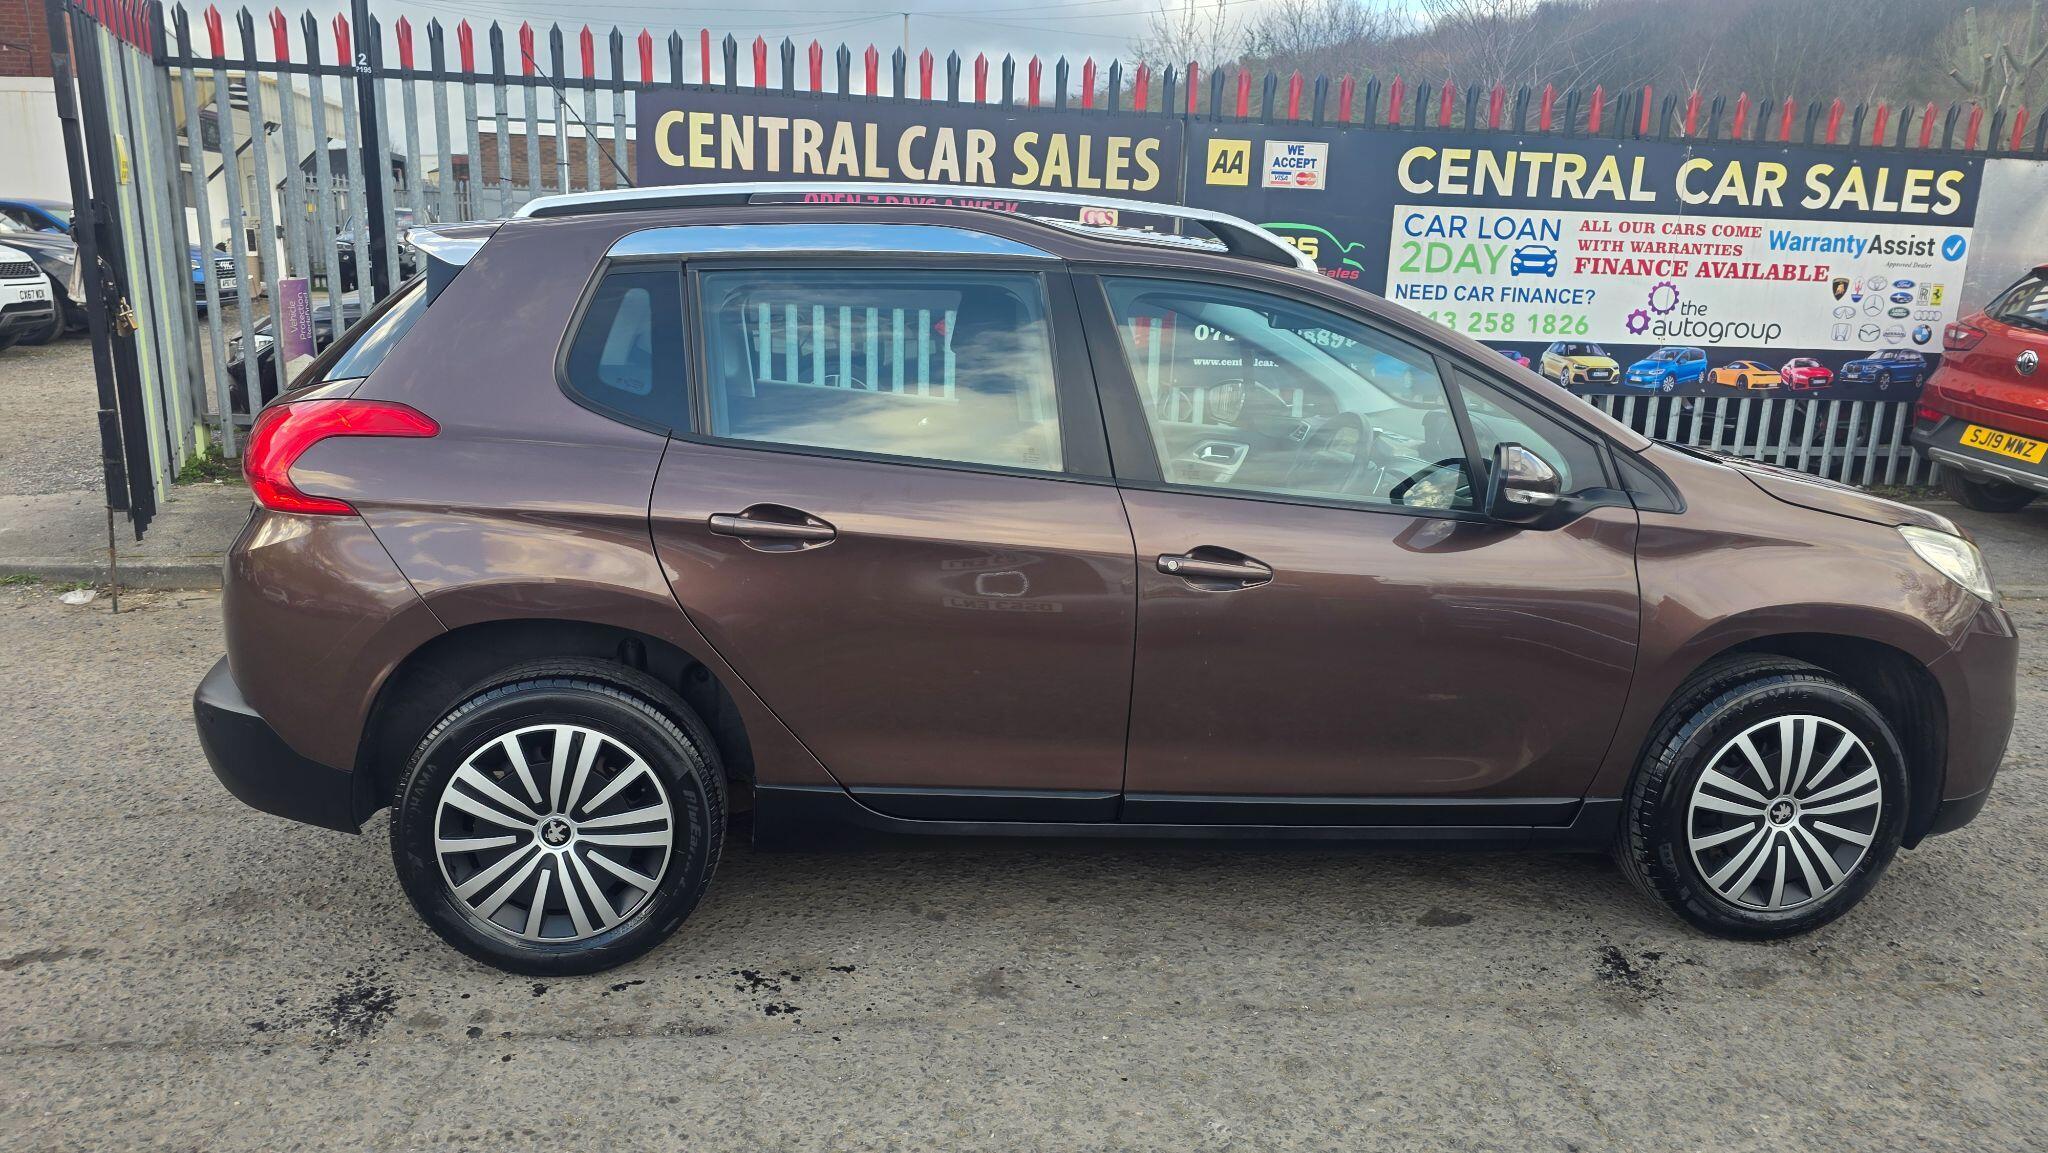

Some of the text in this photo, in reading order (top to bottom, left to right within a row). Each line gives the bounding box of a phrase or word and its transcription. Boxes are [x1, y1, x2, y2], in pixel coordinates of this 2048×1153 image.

[358, 53, 367, 65] 2
[655, 111, 1160, 192] CENTRAL CAR SALES
[1211, 149, 1244, 174] AA
[1287, 144, 1305, 156] WE
[1272, 157, 1318, 169] ACCEPT
[1398, 146, 1965, 215] CENTRAL CAR SALES
[1404, 213, 1562, 241] CAR LOAN
[1578, 220, 1763, 239] ALL OUR CARS COME
[1399, 241, 1509, 275] 2DAY
[1578, 239, 1743, 256] WITH WARRANTIES
[1573, 257, 1830, 283] FINANCE AVAILABLE
[1395, 283, 1596, 305] NEED CAR FINANCE?
[288, 301, 298, 335] Vehicle
[297, 292, 307, 341] Protection
[1680, 300, 1707, 316] the
[1467, 312, 1516, 334] 258
[1527, 313, 1589, 336] 1826
[1652, 316, 1782, 344] autogroup
[1970, 429, 2038, 457] SJ19 MWZ
